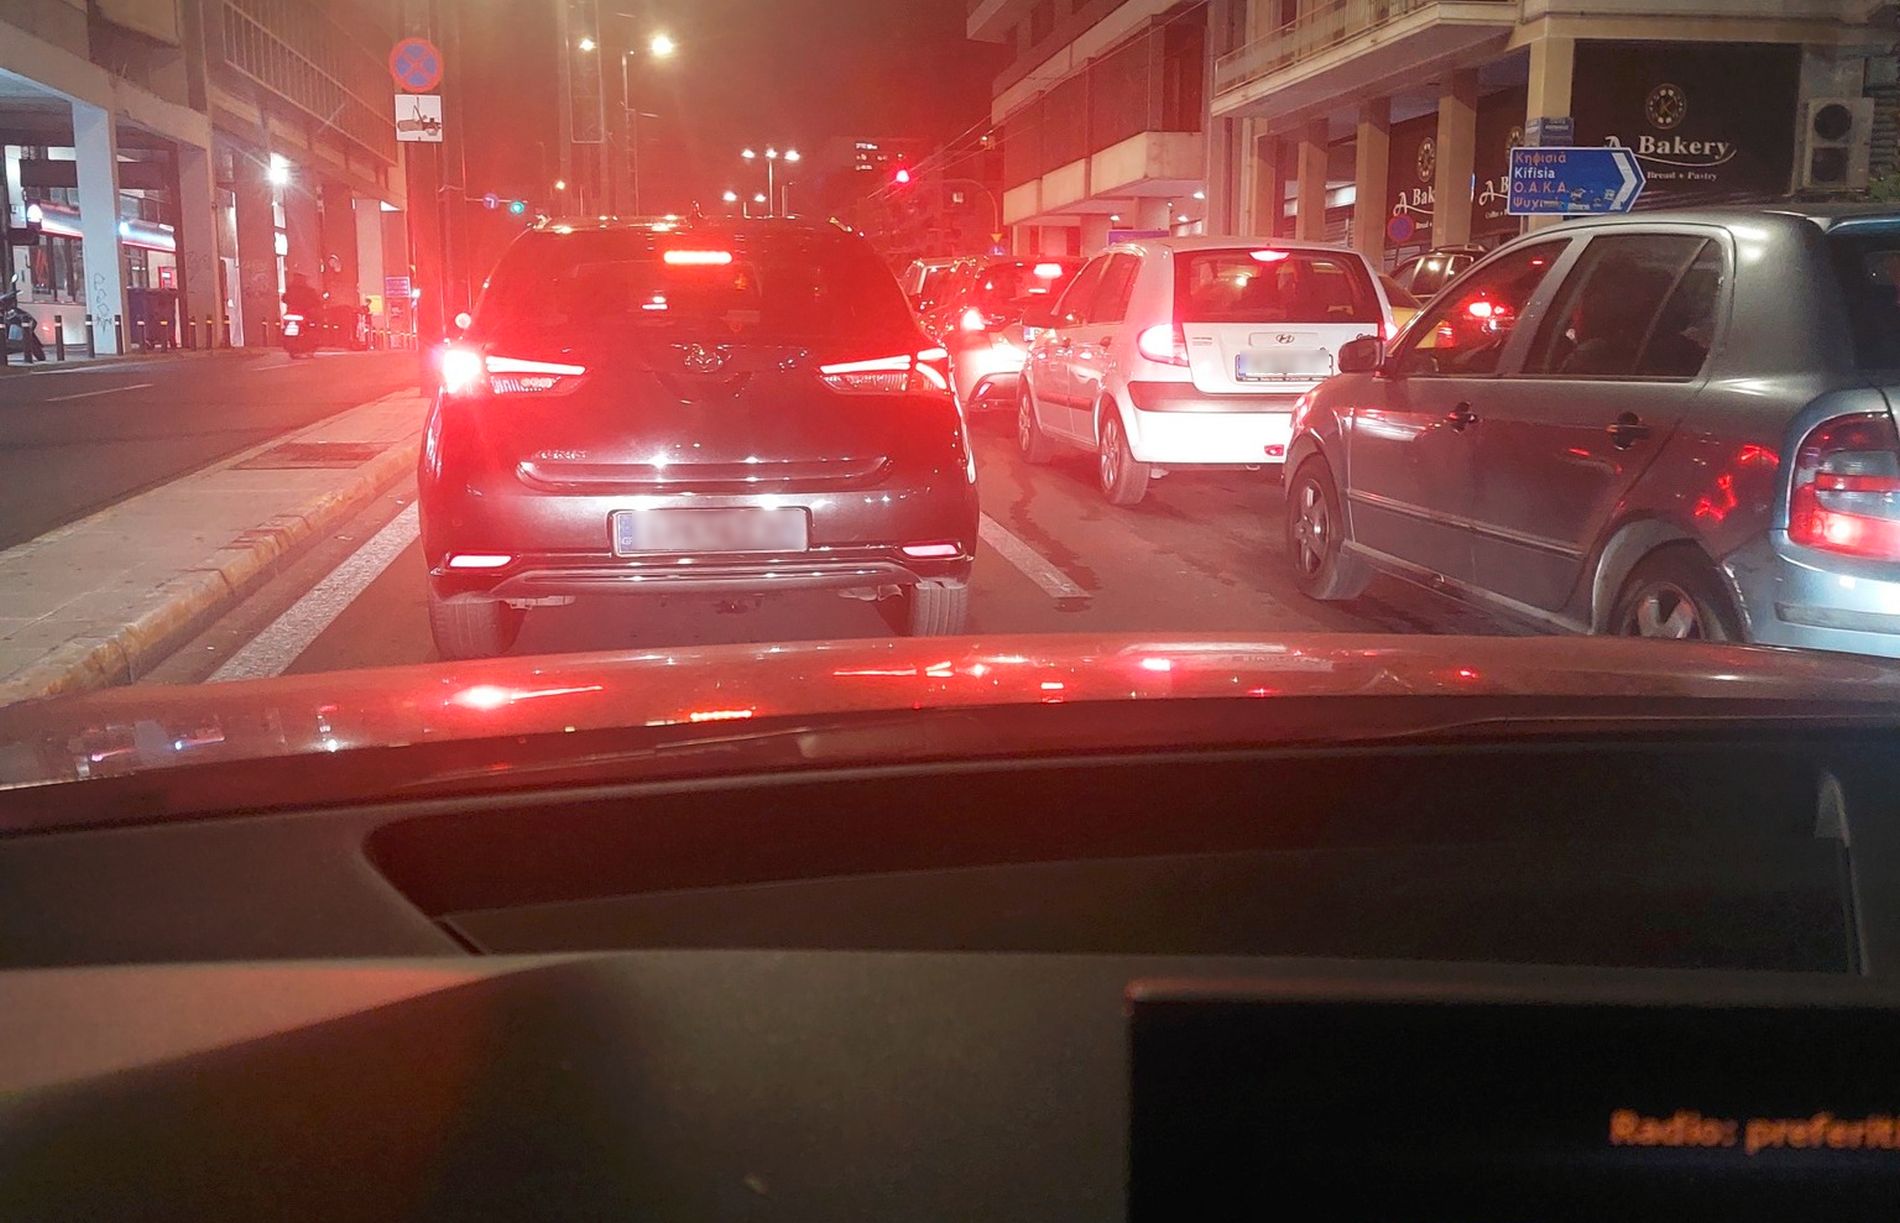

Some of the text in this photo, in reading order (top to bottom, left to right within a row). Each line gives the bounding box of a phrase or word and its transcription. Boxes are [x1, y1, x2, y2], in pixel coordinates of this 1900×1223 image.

[1638, 135, 1730, 160] Bakery
[1515, 152, 1567, 165] Κηφισιά
[1514, 166, 1556, 179] Kifisia
[1647, 171, 1717, 182] Bread Pastry
[1413, 185, 1435, 206] Bak
[1479, 179, 1495, 206] A
